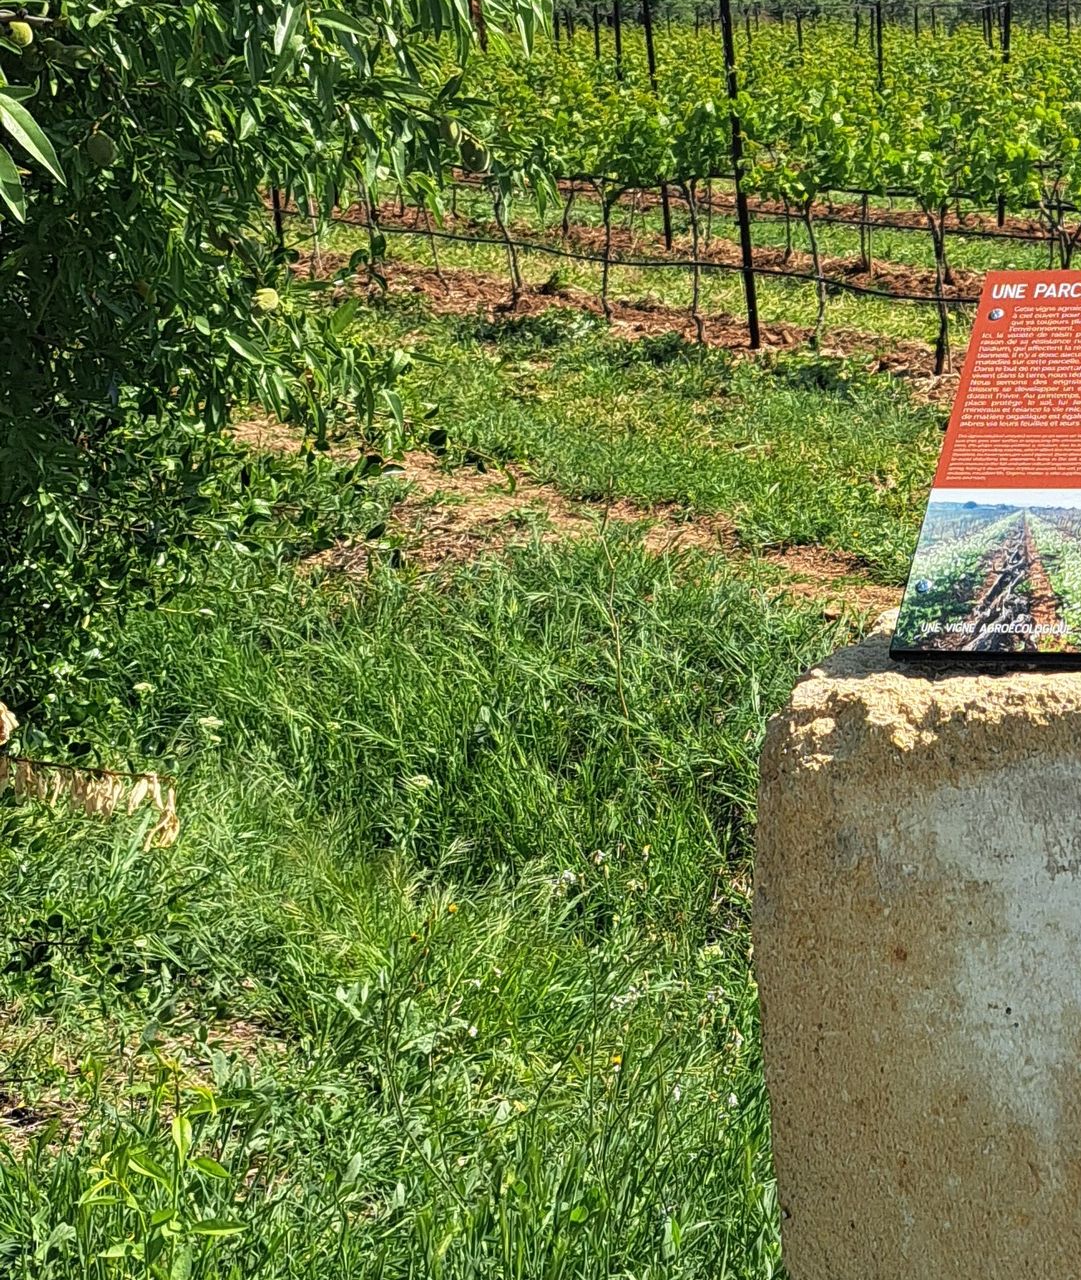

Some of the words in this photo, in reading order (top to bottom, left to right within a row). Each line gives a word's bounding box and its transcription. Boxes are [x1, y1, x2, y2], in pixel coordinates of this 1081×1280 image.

[992, 283, 1027, 299] UNE
[921, 622, 941, 633] UNE
[945, 622, 975, 634] VIGNE
